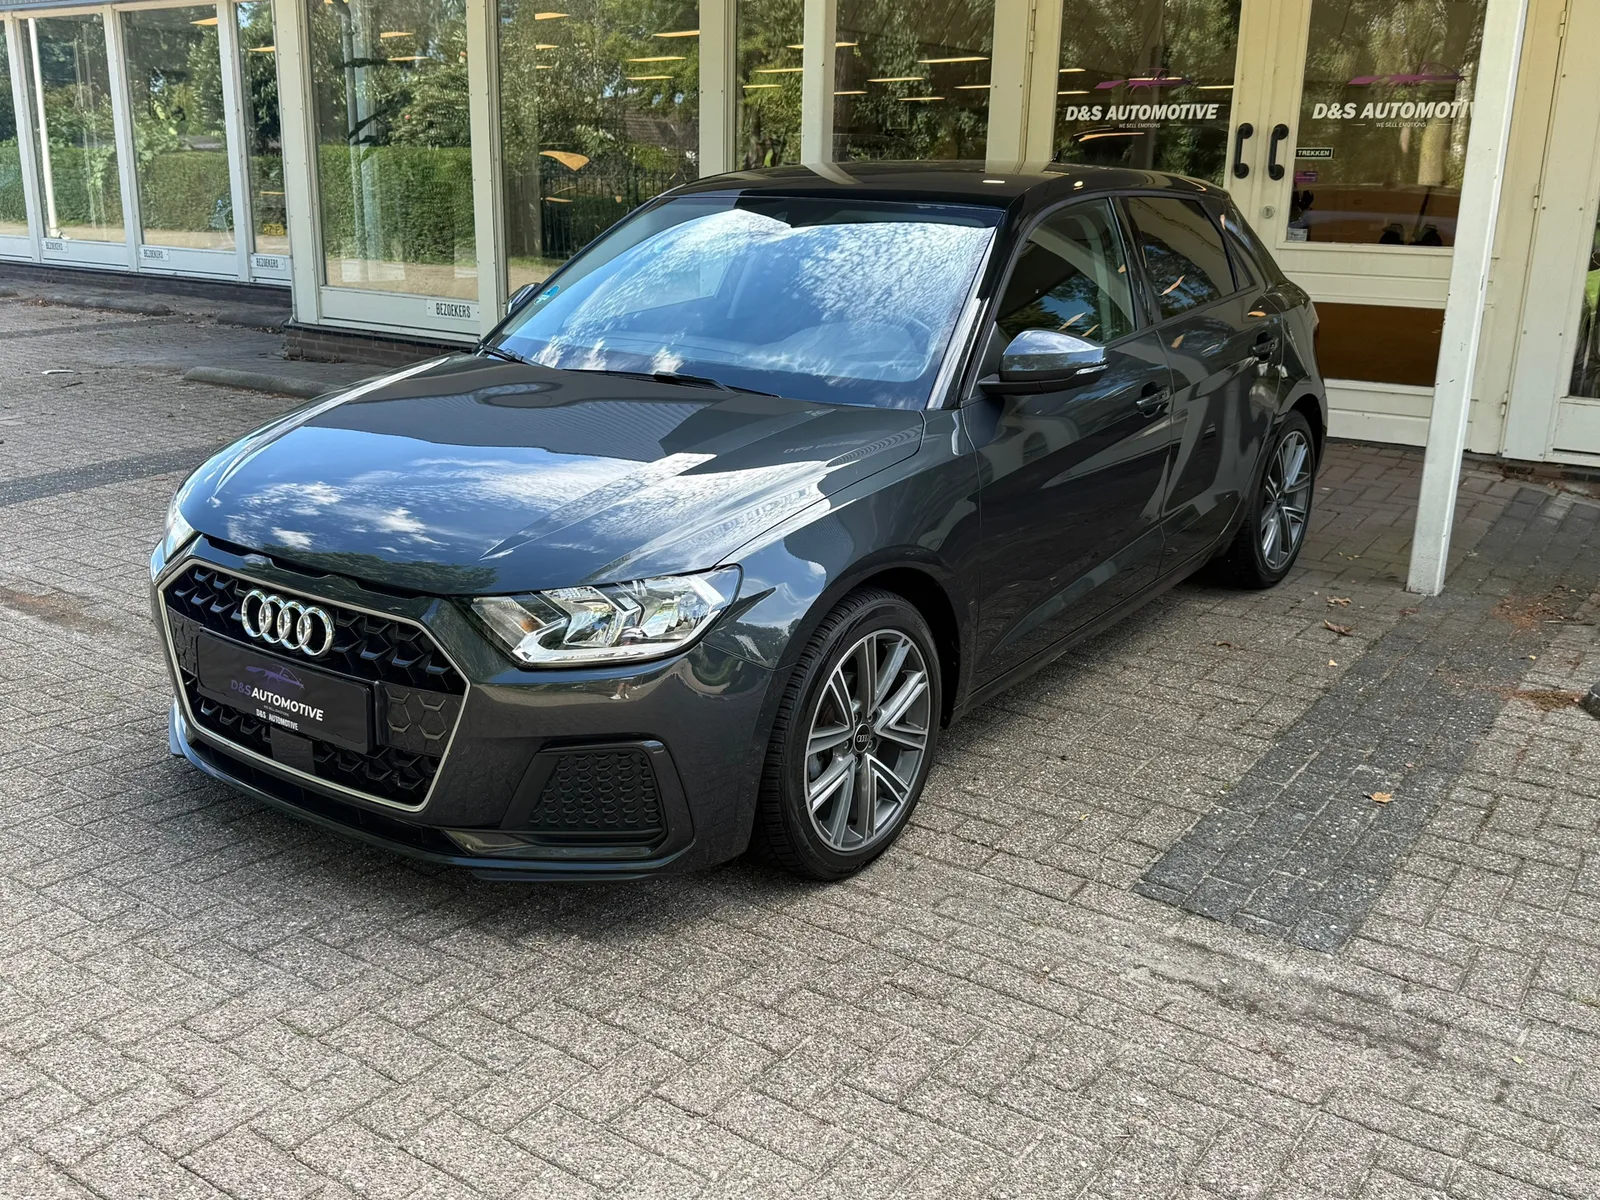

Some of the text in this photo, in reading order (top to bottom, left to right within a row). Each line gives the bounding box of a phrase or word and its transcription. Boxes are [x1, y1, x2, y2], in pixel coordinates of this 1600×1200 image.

[1065, 103, 1220, 121] D&S AUTOMOTIVE
[1312, 102, 1357, 120] D&S
[435, 302, 471, 318] BEZOEKERS
[230, 679, 252, 696] D&S
[251, 687, 324, 721] AUTOMOTIVE
[256, 708, 267, 719] D&S
[268, 713, 299, 731] AUTOMOTIVE
